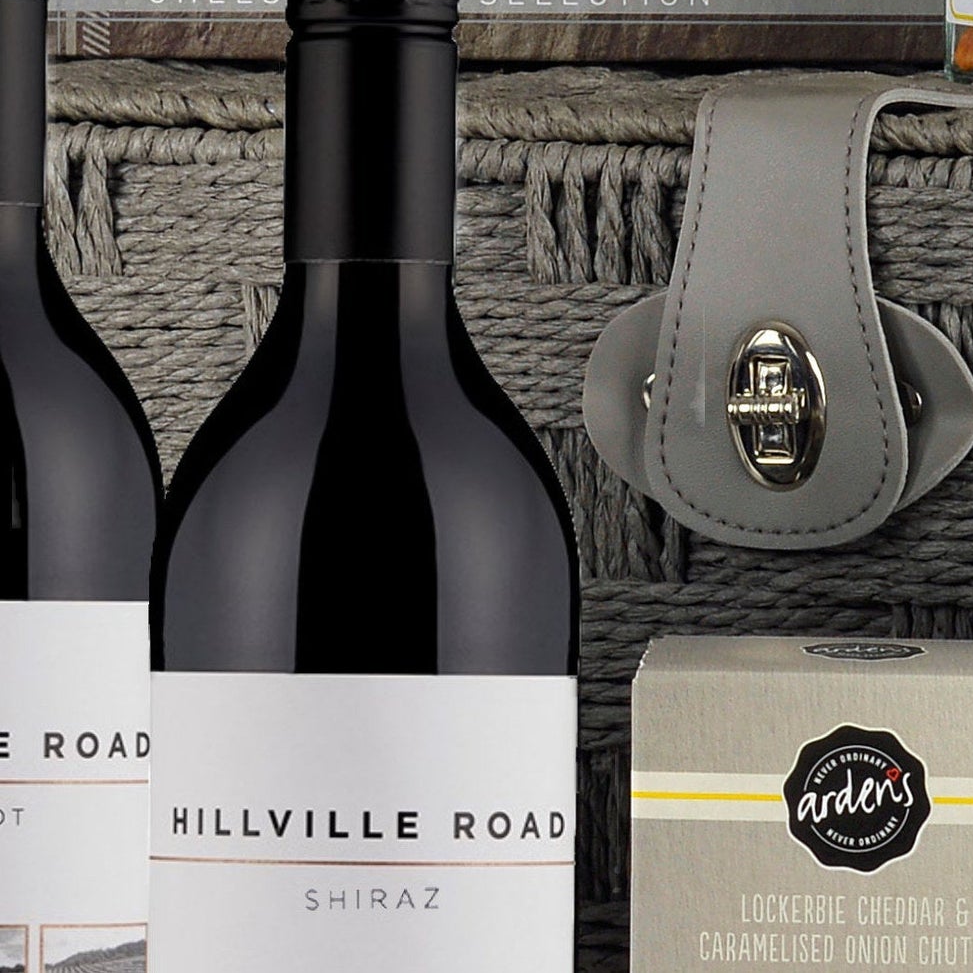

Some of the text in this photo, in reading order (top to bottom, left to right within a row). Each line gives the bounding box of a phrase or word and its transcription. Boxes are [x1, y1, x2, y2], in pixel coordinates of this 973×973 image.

[44, 732, 150, 758] ROAD
[813, 752, 888, 785] NEVER ORDINARY
[173, 807, 566, 841] HILLVILLE ROAD
[826, 815, 899, 847] NEVER ORDINARY
[305, 887, 441, 911] SHIRAZ
[741, 893, 969, 927] LOCKERBIE CHEDDAR &
[699, 931, 834, 963] CARAMELISED
[846, 934, 907, 965] ONION
